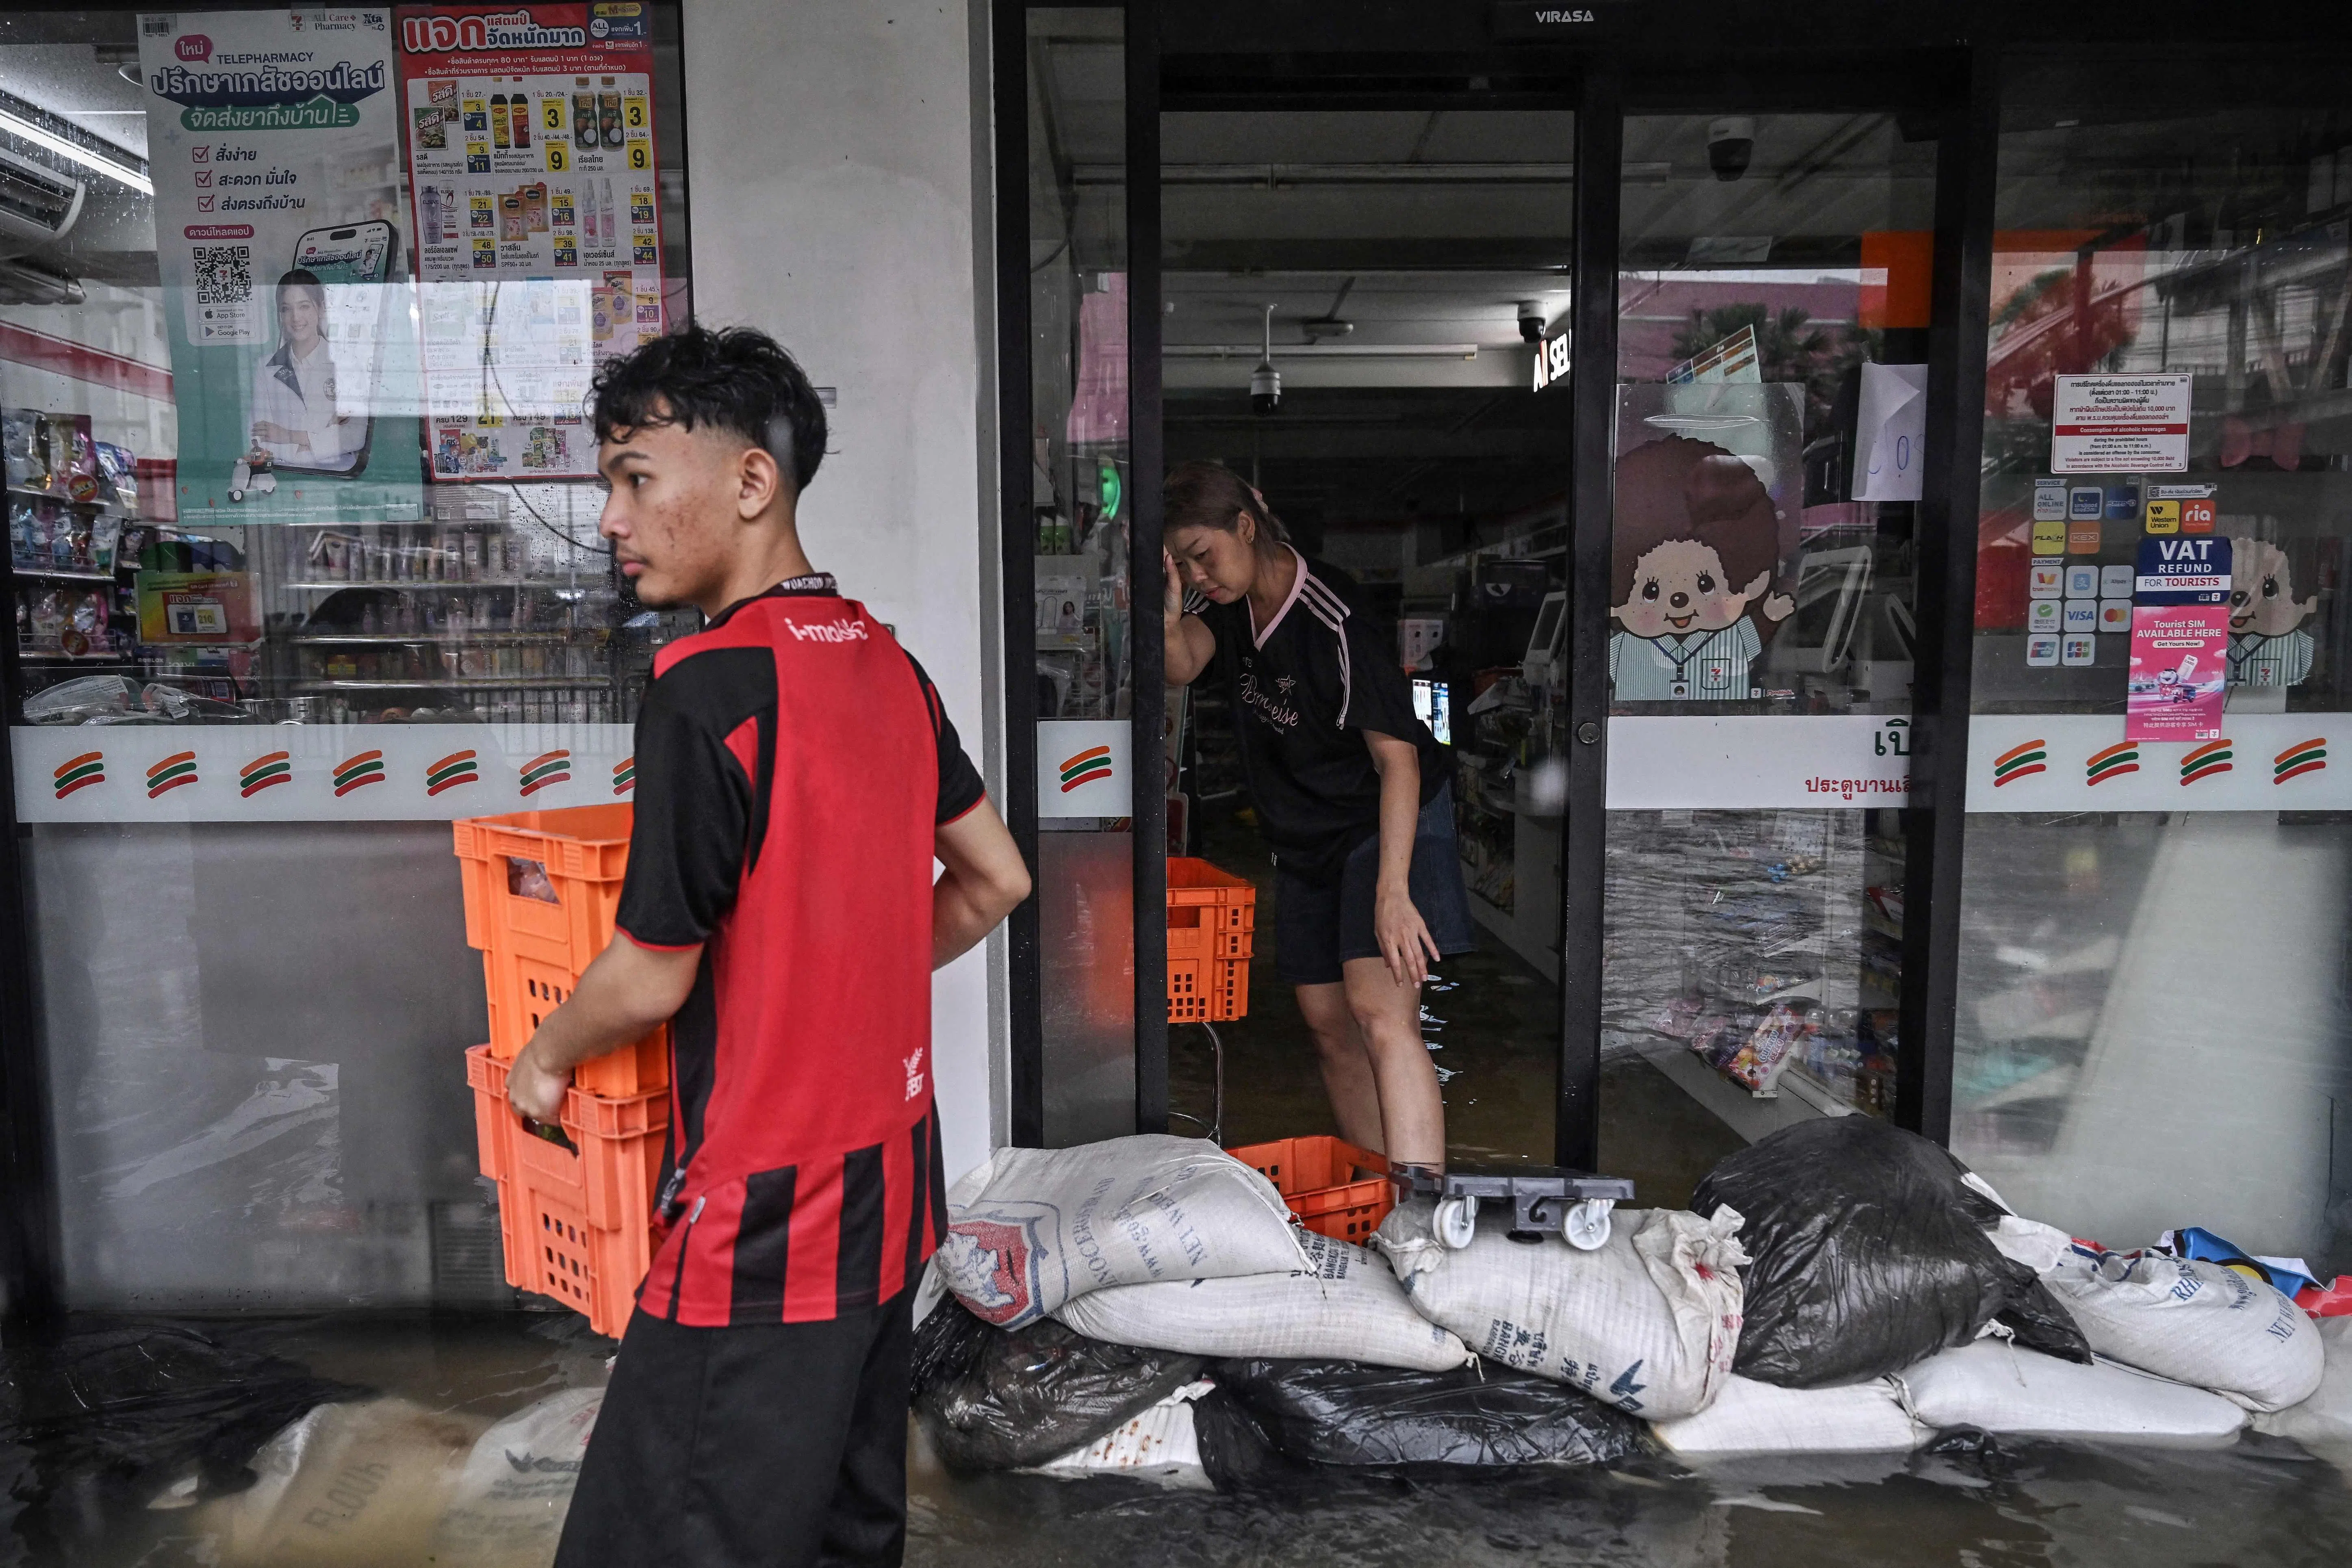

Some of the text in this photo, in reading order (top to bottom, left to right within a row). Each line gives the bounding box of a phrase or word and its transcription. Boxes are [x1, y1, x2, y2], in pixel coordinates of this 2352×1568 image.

[487, 13, 527, 26] แสตมป์
[1535, 10, 1594, 23] VIRASA
[315, 23, 356, 31] Pharmacy
[406, 19, 486, 49] แจก
[611, 24, 634, 33] แจกเพิ่ม
[487, 27, 582, 45] จัดหนักมาก
[180, 40, 204, 56] ใหม่
[217, 52, 314, 64] TELEPHARMACY
[152, 61, 384, 94] ปรึกษาเภสัชออนไลน์
[427, 66, 488, 76] ซื้อสินค้าที่ร่วมรายการ
[584, 63, 626, 72] (ตามที่กำหนด)
[432, 85, 453, 103] รสดี
[191, 103, 328, 127] จัดส่งยาถึงบ้าน
[419, 111, 440, 129] รสดี
[216, 143, 257, 162] สั่งง่าย
[494, 150, 508, 159] แม็กกี้
[578, 155, 603, 163] เรียลไทย
[219, 167, 297, 187] สะดวก มั่นใจ
[221, 194, 306, 211] ส่งตรงถึงบ้าน
[189, 226, 249, 236] ดาวน์โหลดแอป
[2185, 504, 2211, 521] ria
[2159, 540, 2213, 560] VAT
[2158, 564, 2212, 573] REFUND
[2165, 577, 2220, 586] TOURISTS
[2066, 611, 2094, 620] VISA
[2188, 620, 2205, 628] SIM
[2137, 629, 2222, 638] AVAILABLE HERE
[1758, 1030, 1780, 1063] GUMMY
[1178, 1225, 1209, 1267] NET
[2265, 1316, 2296, 1343] NET
